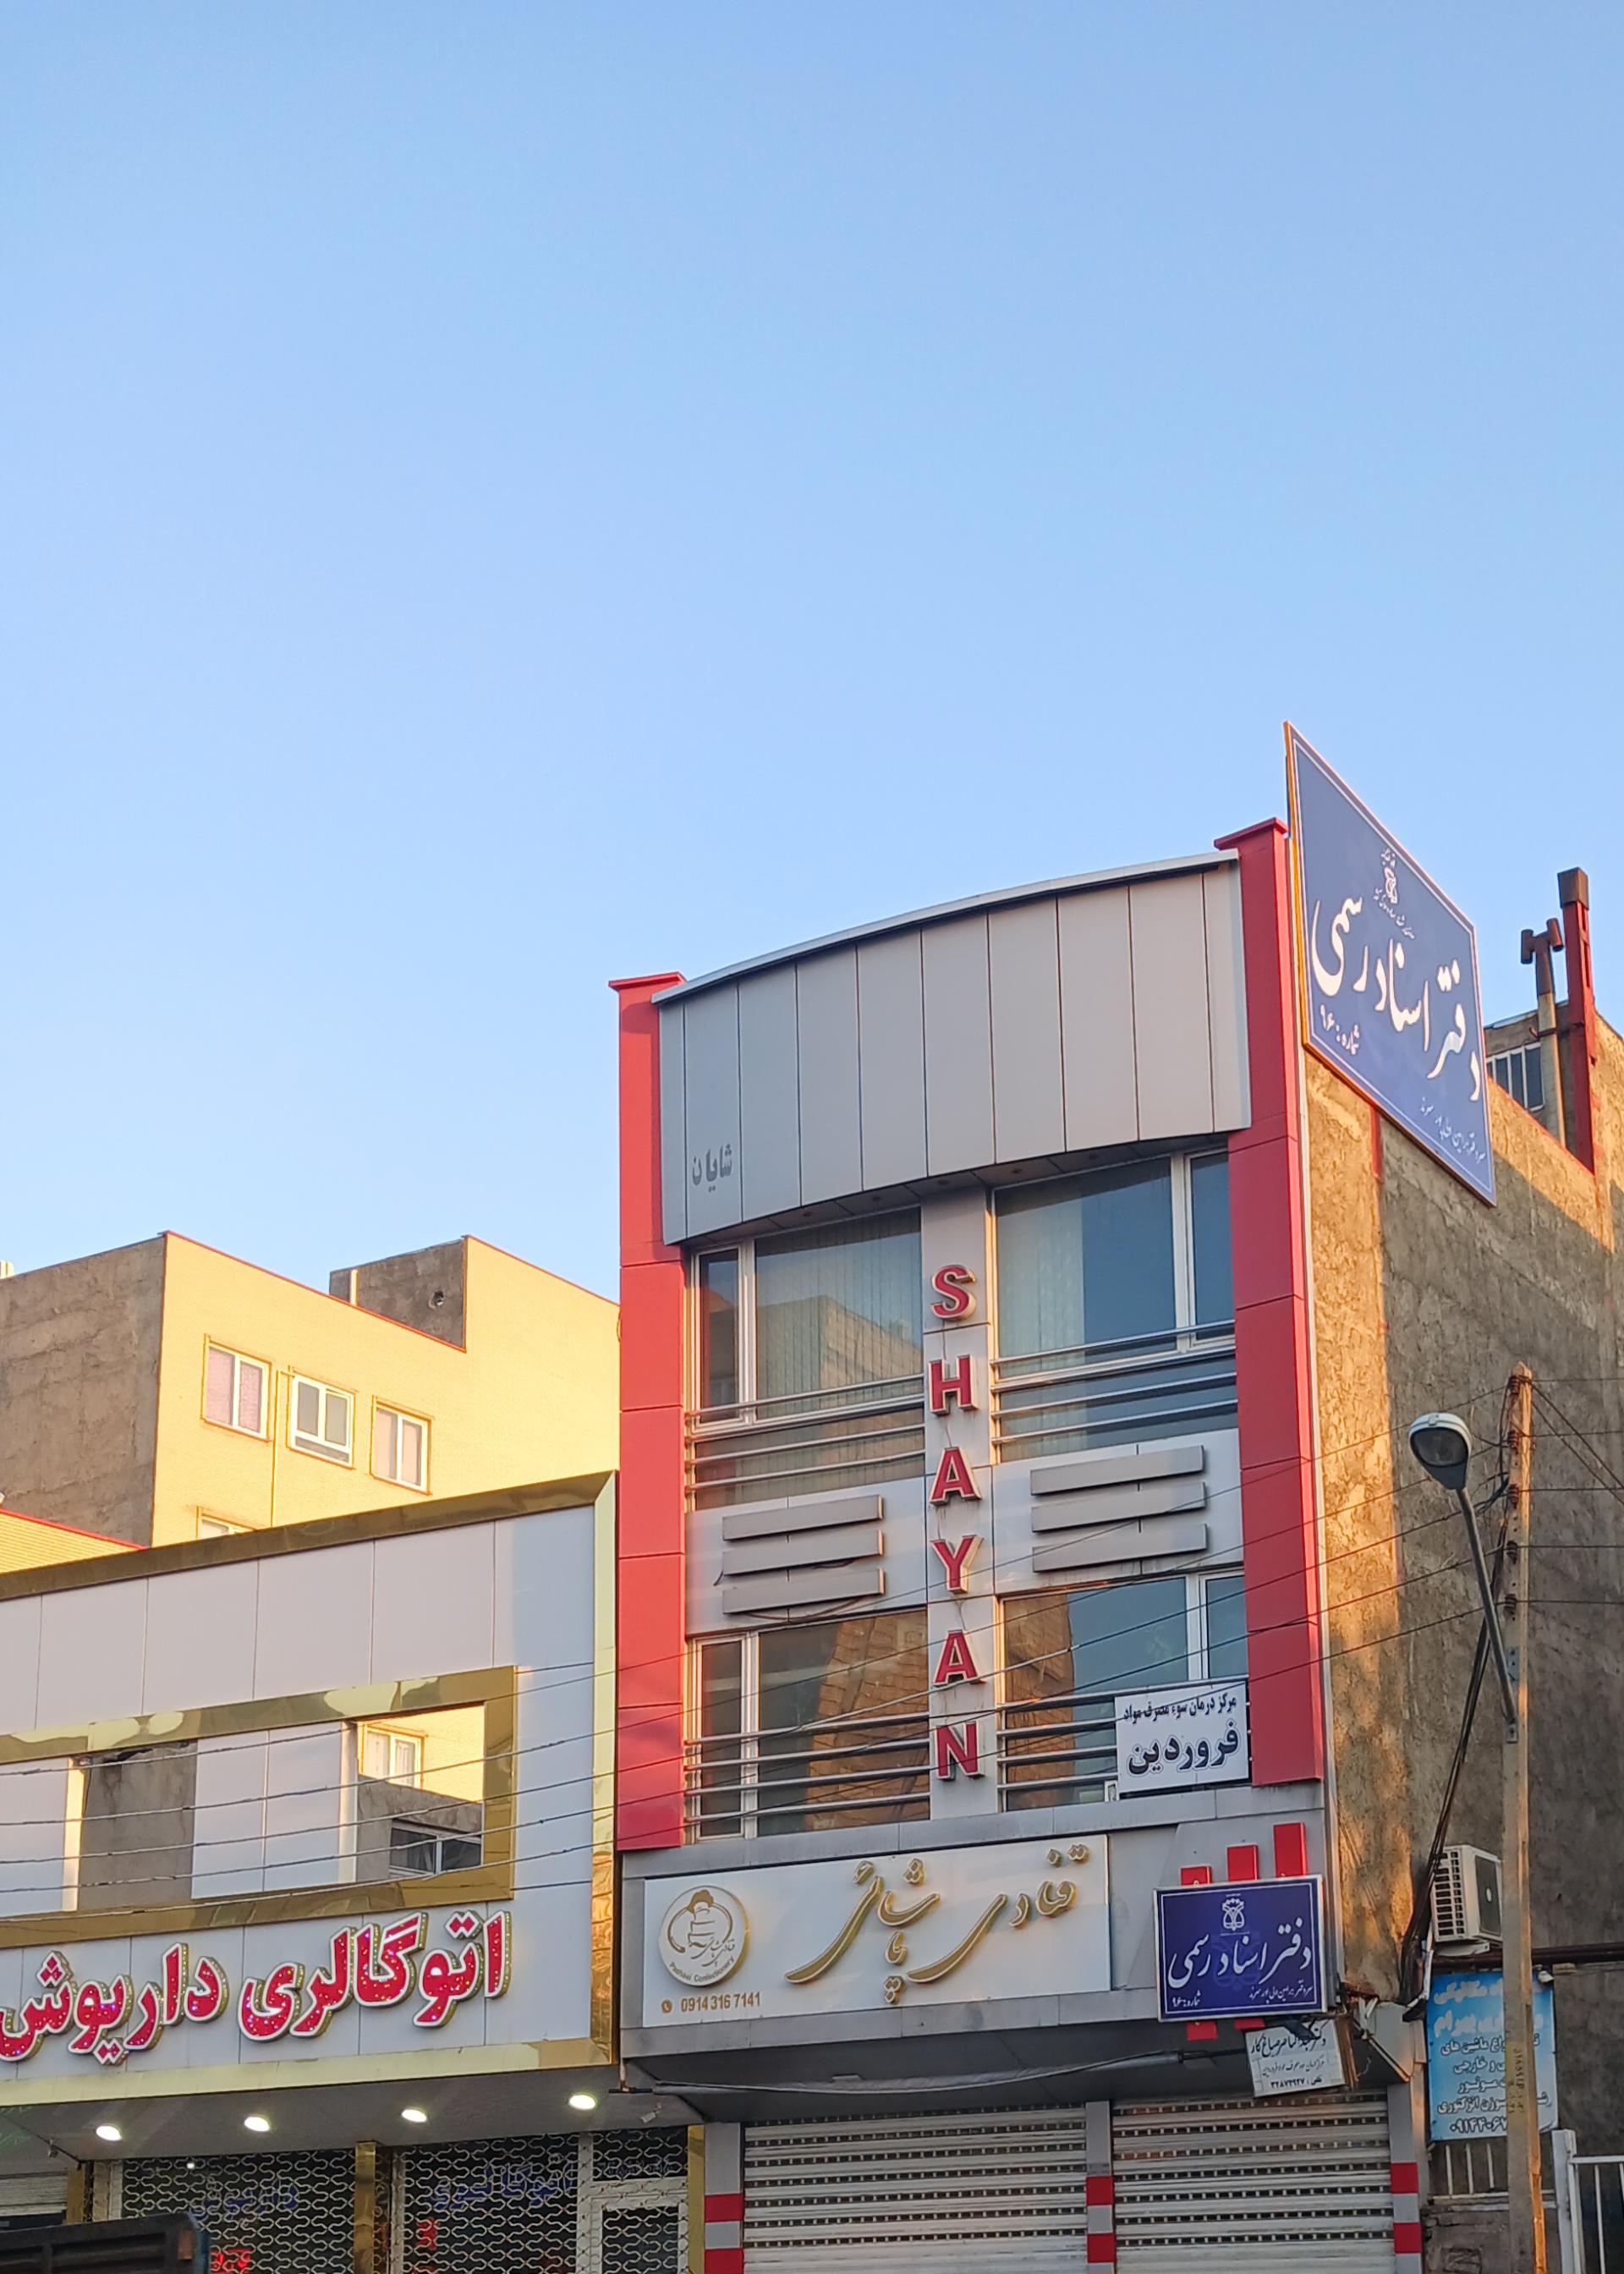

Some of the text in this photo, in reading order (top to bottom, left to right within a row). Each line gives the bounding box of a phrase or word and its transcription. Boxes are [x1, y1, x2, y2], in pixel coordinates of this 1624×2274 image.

[1311, 895, 1369, 997] رسمی
[1374, 938, 1429, 1052] اسناد
[1427, 959, 1480, 1101] دفتر
[692, 1143, 732, 1193] شایان
[929, 1264, 986, 1782] SHAYAN
[1144, 1700, 1170, 1722] مصرف
[1189, 1695, 1215, 1716] درمان
[1219, 1692, 1237, 1714] مرکز
[1128, 1720, 1239, 1775] فروردین
[906, 1843, 1090, 1984] قنادی
[1167, 1917, 1312, 1989] دفتر اسناد رسمی
[0, 1942, 228, 2066] داریوش
[1454, 2056, 1487, 2074] خارجی
